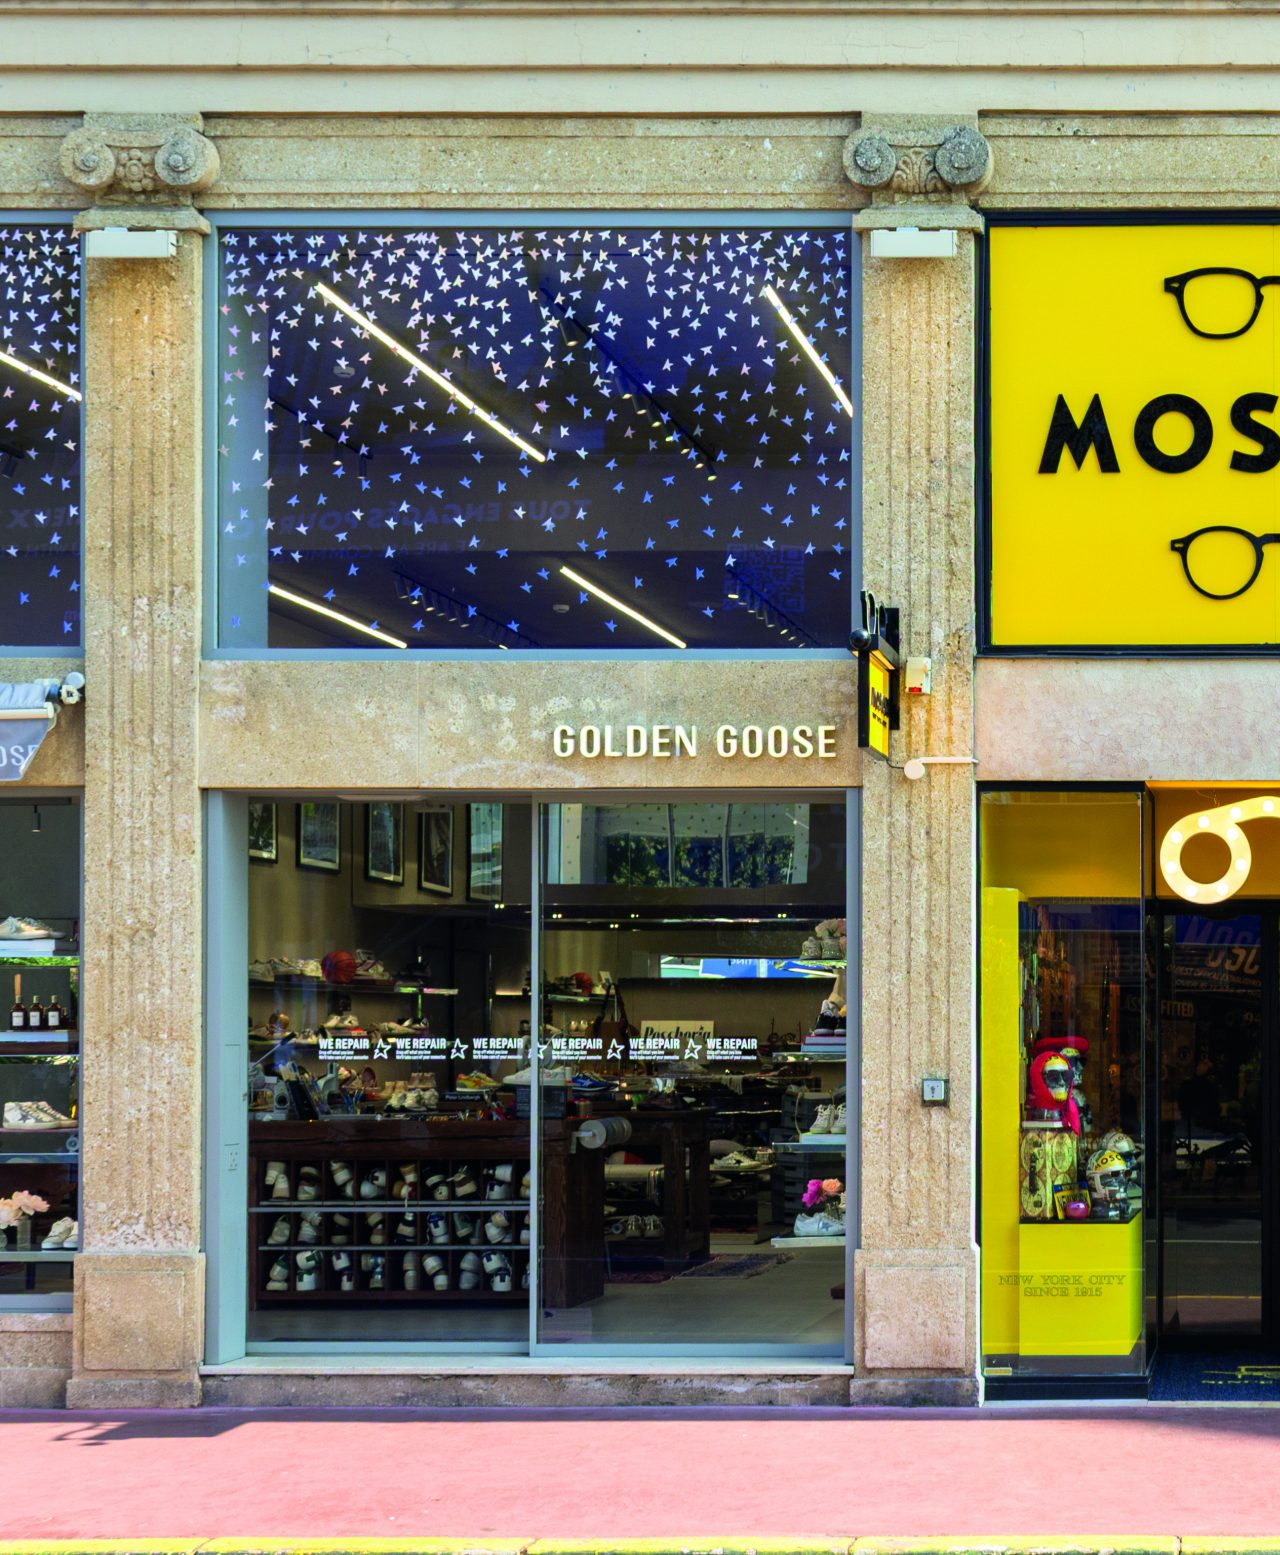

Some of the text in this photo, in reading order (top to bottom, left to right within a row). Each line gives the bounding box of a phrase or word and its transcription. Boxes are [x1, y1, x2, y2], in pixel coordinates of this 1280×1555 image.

[553, 724, 837, 758] GOLDEN GOOSE
[319, 1038, 369, 1049] WE REPAIR
[396, 1038, 446, 1049] WE REPAIR
[473, 1038, 523, 1049] WE REPAIR
[552, 1038, 602, 1049] WE REPAIR
[630, 1038, 680, 1049] WE REPAIR
[707, 1038, 757, 1049] WE REPAIR
[999, 1275, 1126, 1286] NEW YORK CITY
[1023, 1286, 1103, 1297] SINCE 1915
